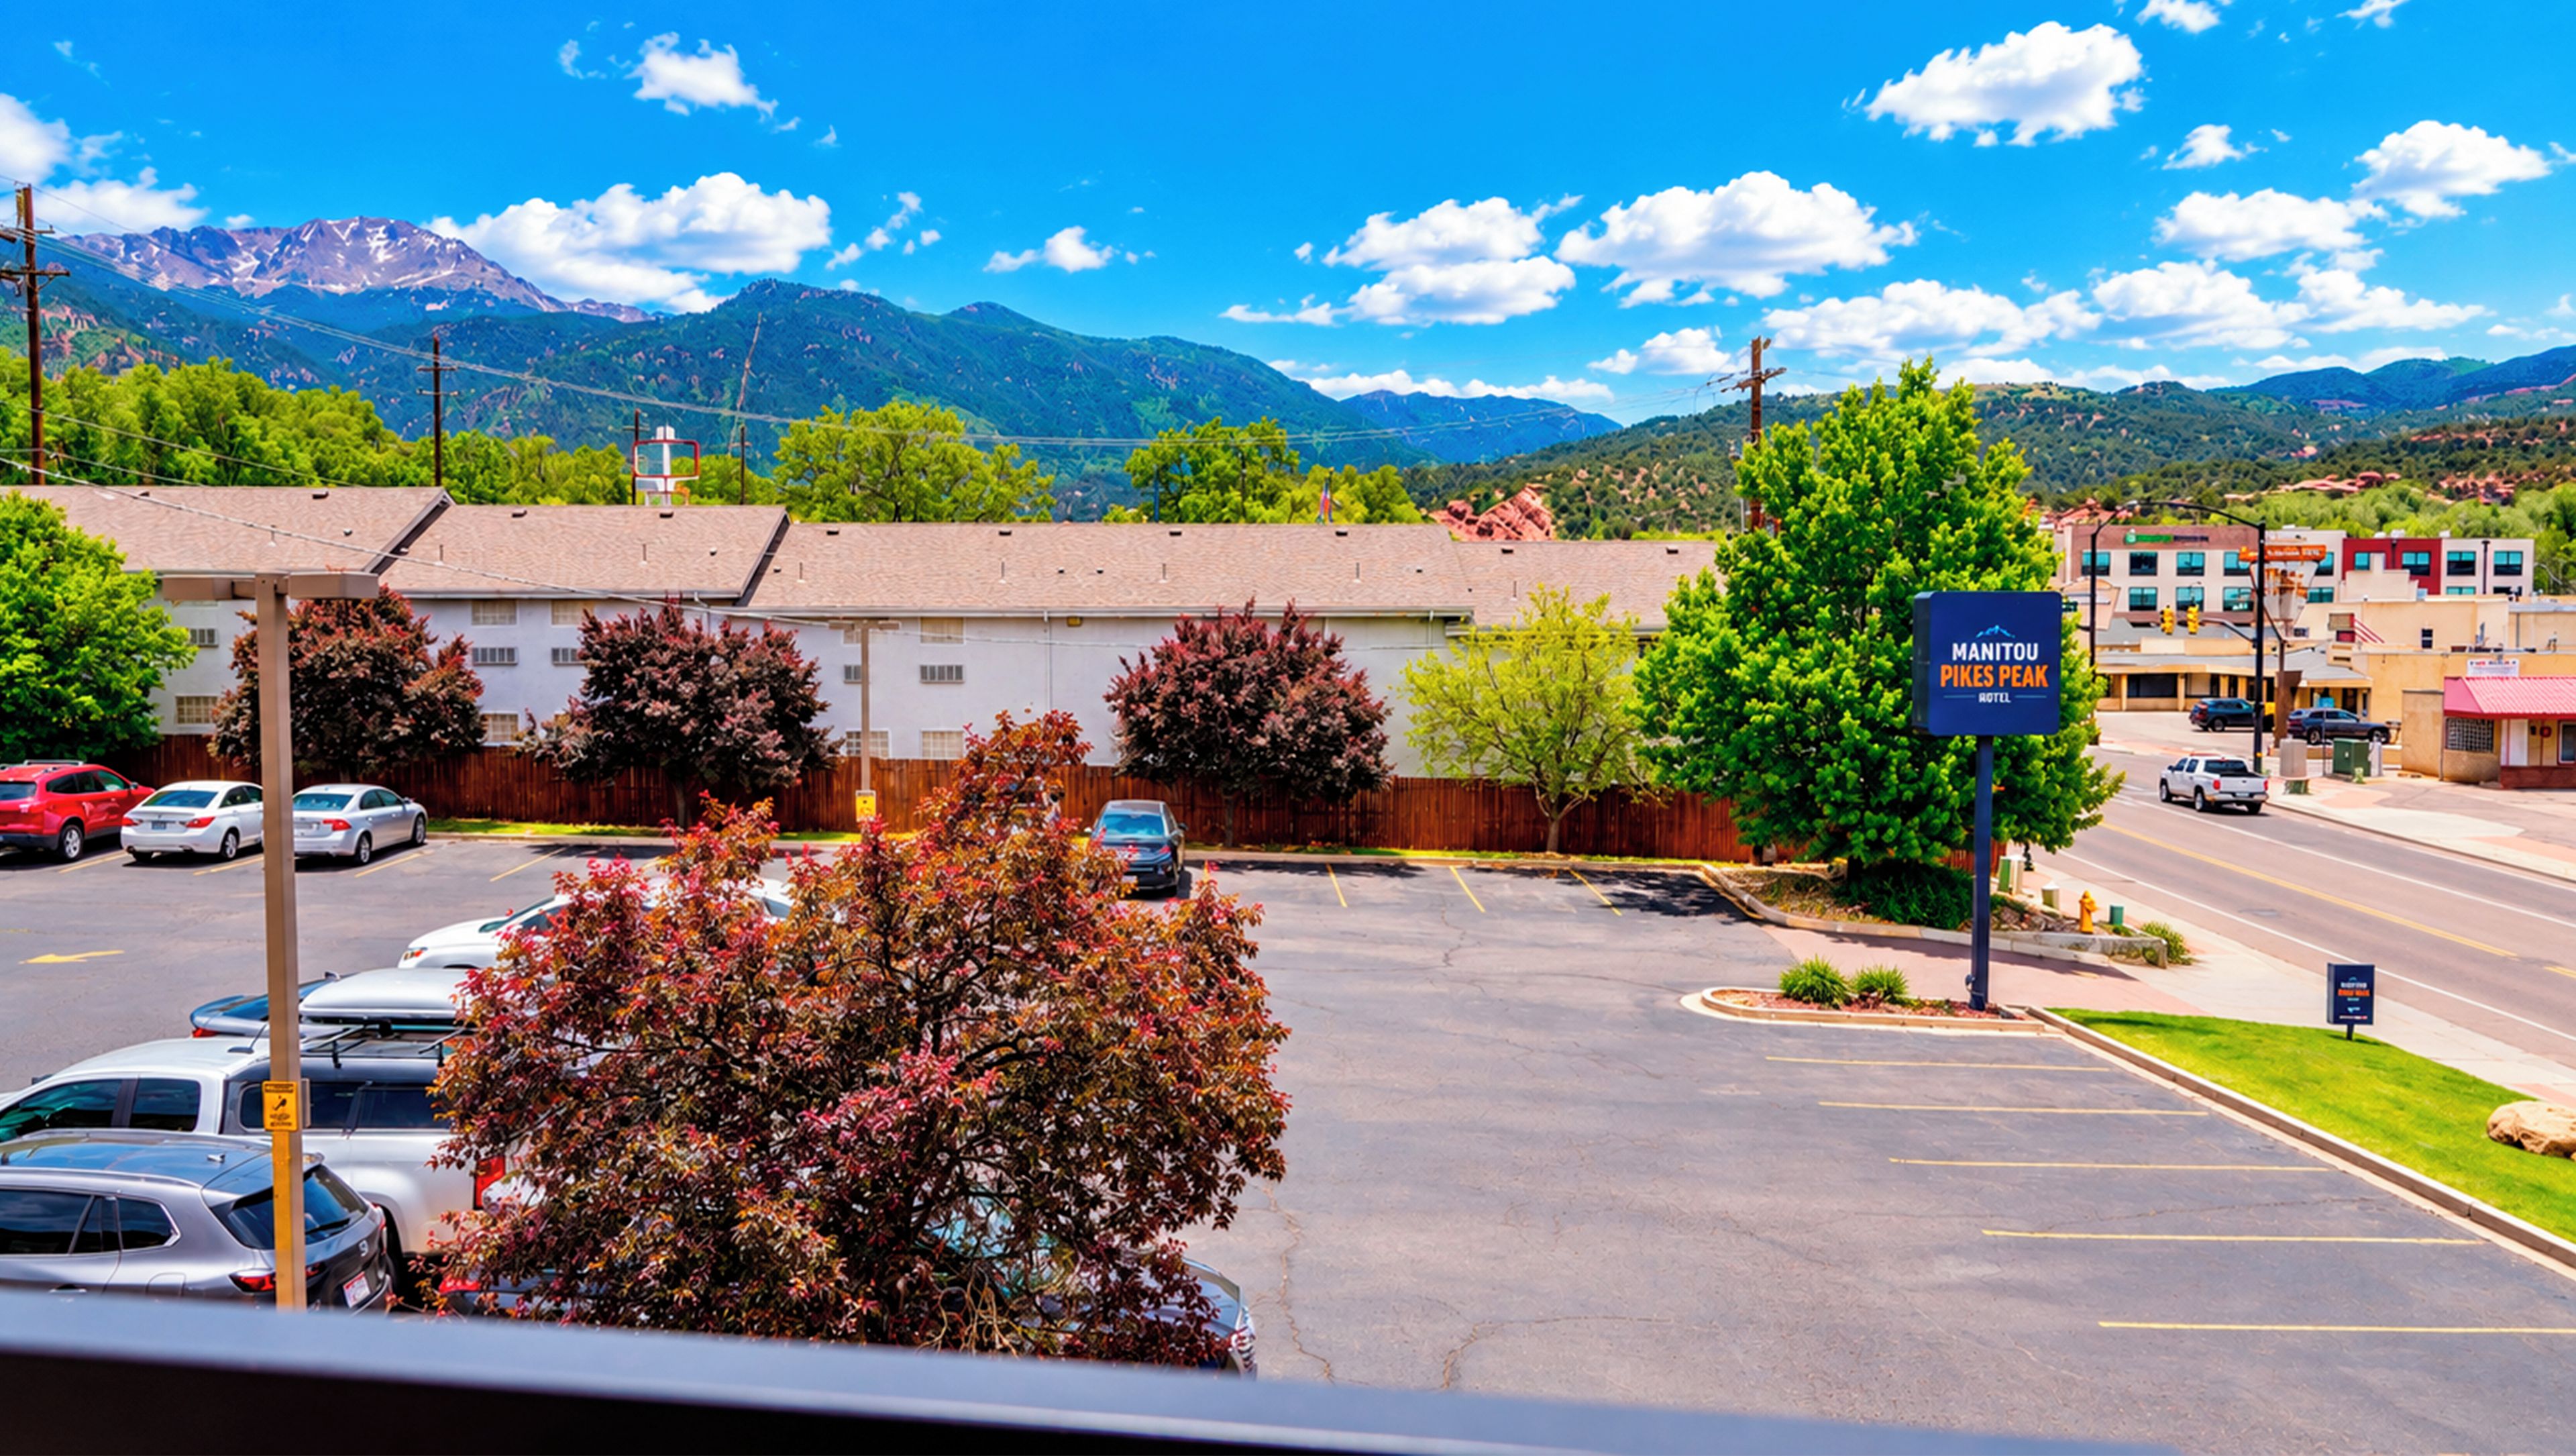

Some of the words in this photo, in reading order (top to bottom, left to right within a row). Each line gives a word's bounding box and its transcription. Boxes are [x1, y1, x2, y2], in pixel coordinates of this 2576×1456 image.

[1952, 642, 2038, 661] MANITOU
[1940, 664, 1994, 688] PIKES
[1998, 664, 2049, 688] PEAK
